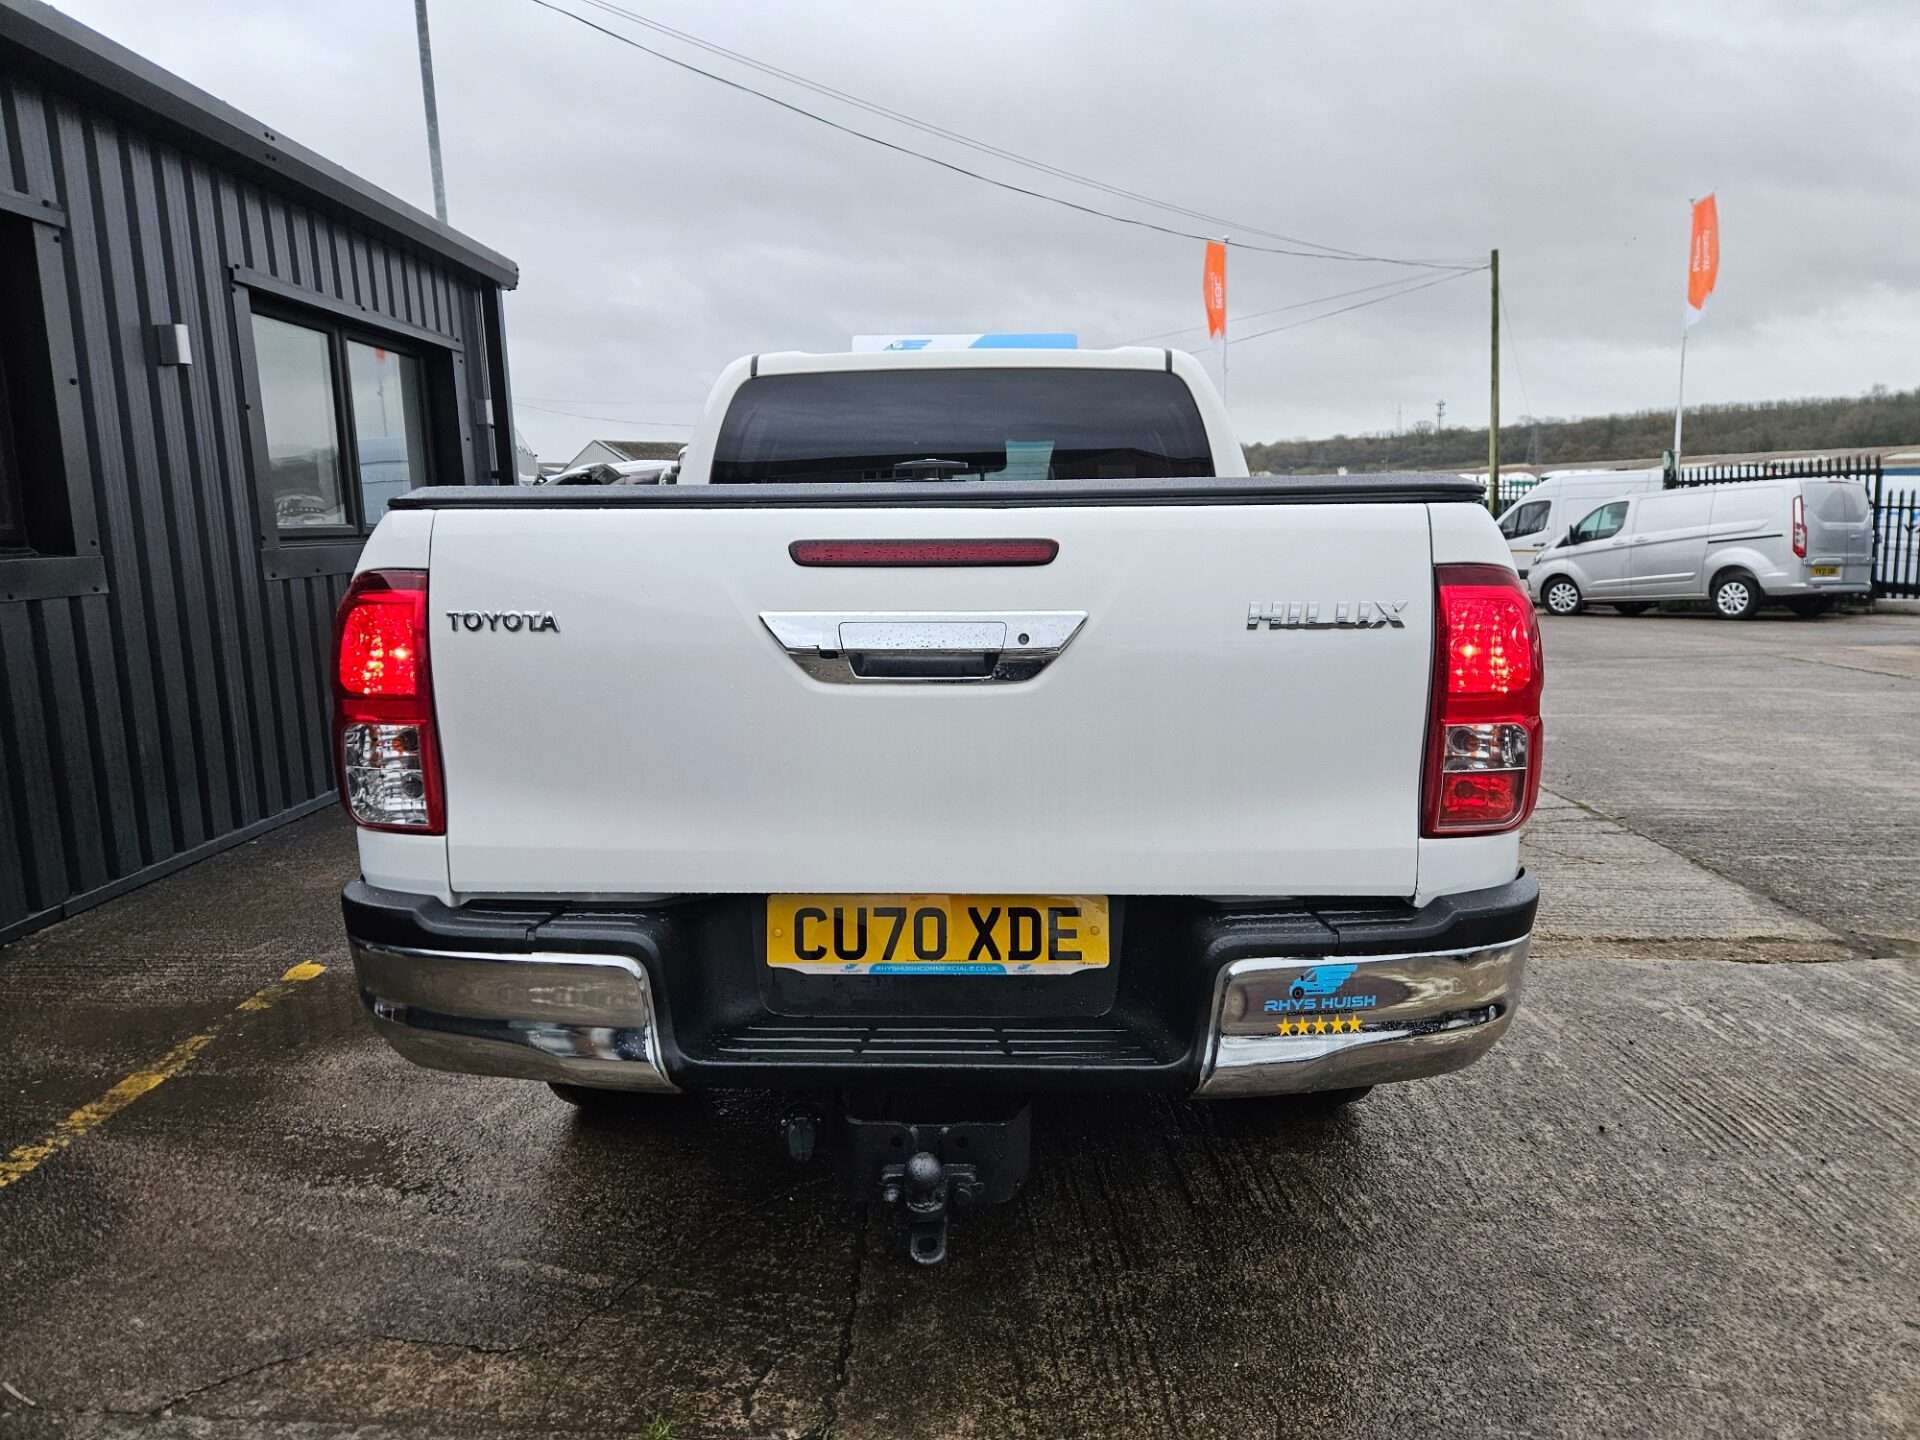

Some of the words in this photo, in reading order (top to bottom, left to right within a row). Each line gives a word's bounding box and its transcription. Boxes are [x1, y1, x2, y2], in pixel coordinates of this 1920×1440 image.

[446, 610, 560, 633] TOYOTA
[1247, 600, 1408, 630] HILUX
[793, 906, 948, 961] CU70
[966, 906, 1083, 961] XDE
[1264, 999, 1317, 1011] RHYS
[1321, 995, 1377, 1009] HUISH
